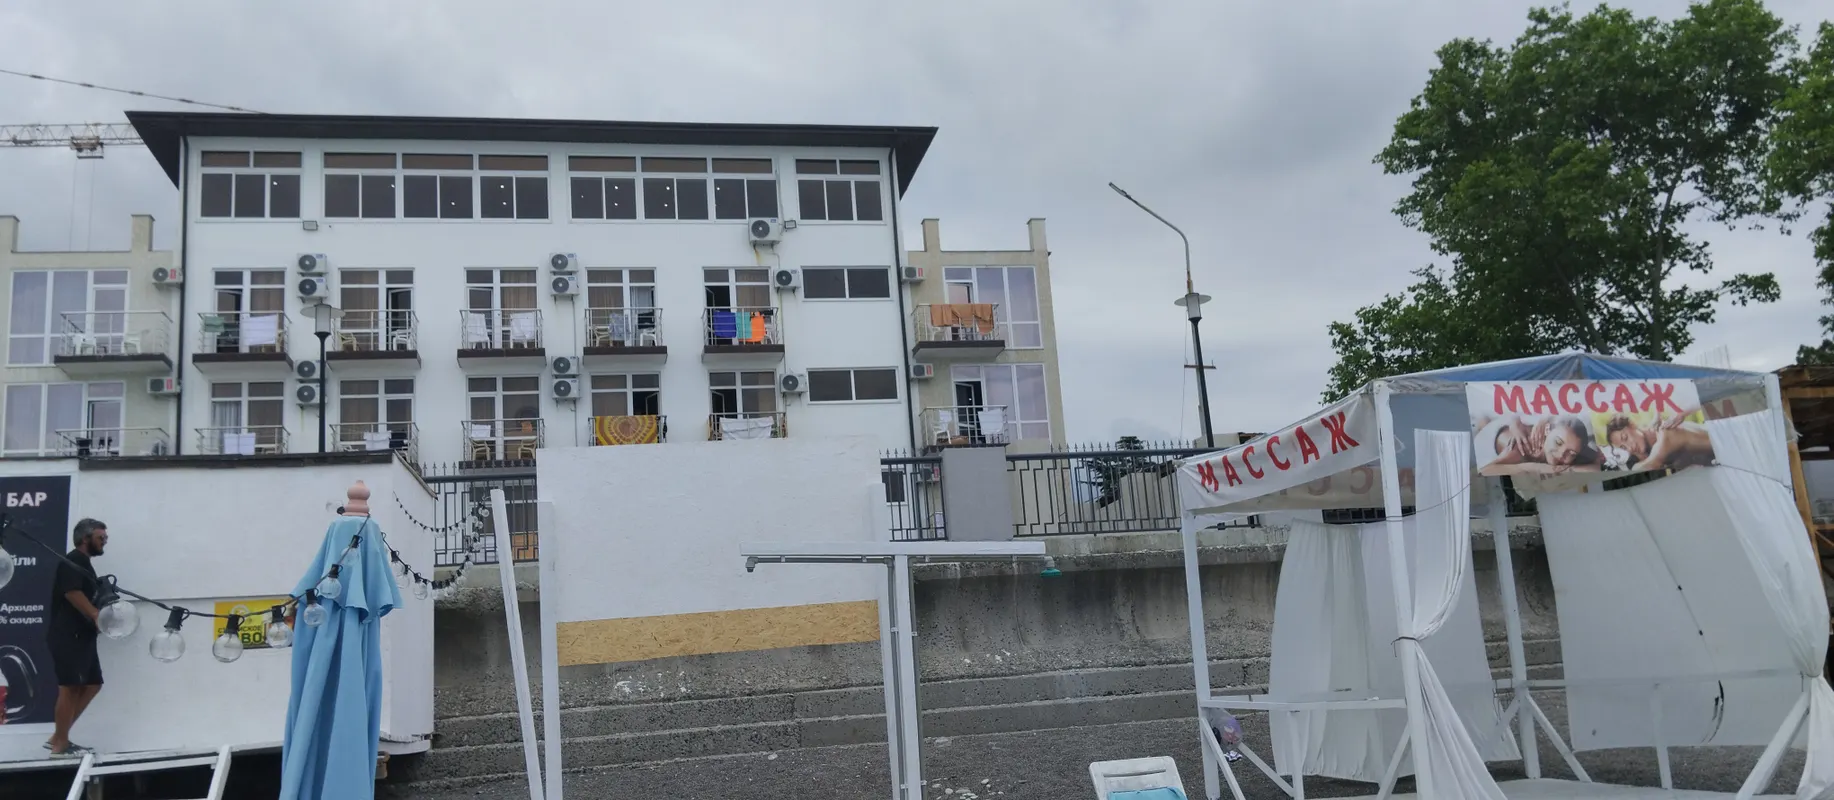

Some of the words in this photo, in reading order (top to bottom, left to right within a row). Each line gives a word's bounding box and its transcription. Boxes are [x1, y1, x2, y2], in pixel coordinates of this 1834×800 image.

[1494, 382, 1685, 416] МАССАЖ
[1197, 411, 1360, 493] МАССАЖ
[6, 492, 47, 507] БАР
[0, 603, 44, 614] Архидея
[10, 616, 43, 624] скидка
